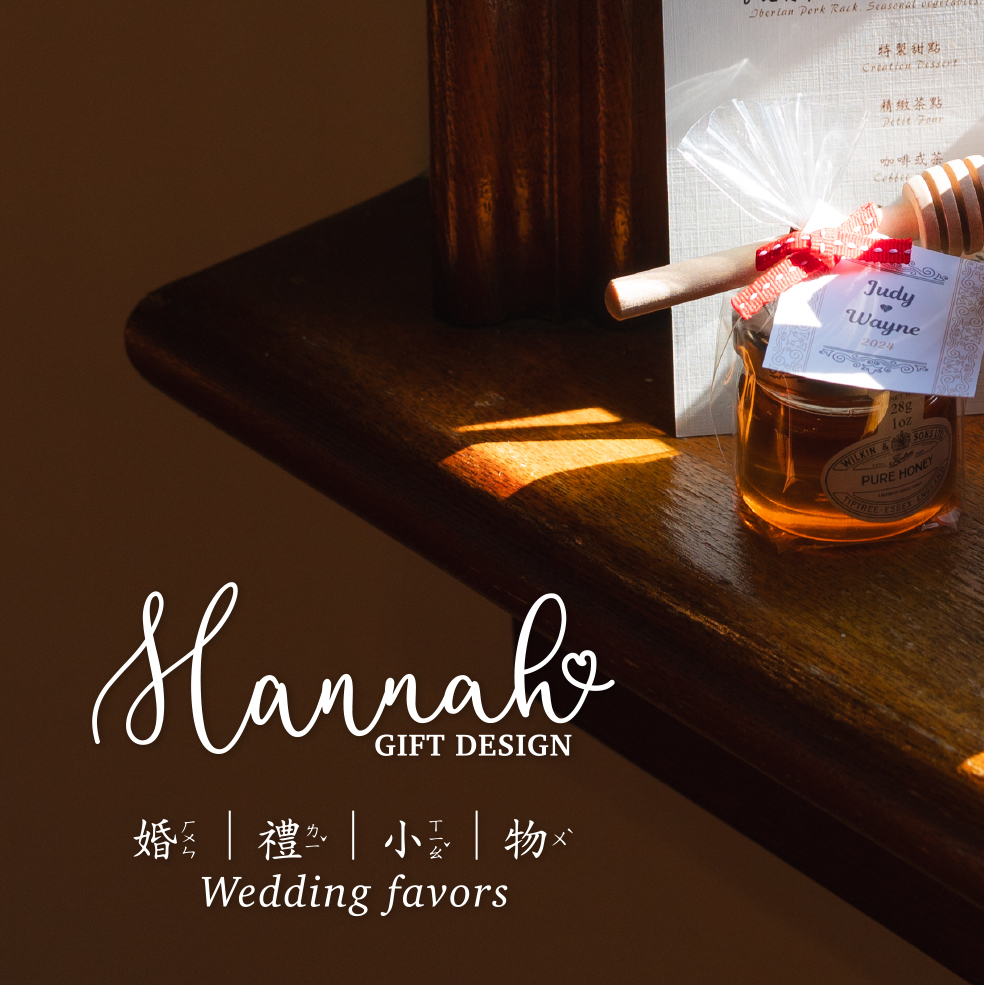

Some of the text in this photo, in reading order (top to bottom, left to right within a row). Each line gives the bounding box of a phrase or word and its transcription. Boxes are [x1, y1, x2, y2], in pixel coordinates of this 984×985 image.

[749, 8, 794, 18] Iberian
[798, 3, 826, 16] Pork
[866, 0, 916, 12] Seasonal
[878, 41, 940, 57] 特製甜點
[862, 58, 958, 72] Creation Dessert
[880, 96, 943, 113] 精緻茶點
[881, 115, 911, 127] Petit
[880, 151, 943, 167] 咖啡或茶
[864, 279, 915, 308] Judy
[845, 308, 921, 336] Wayne
[860, 337, 895, 351] 2024
[890, 400, 913, 415] 28g
[892, 416, 913, 430] 1oz
[841, 446, 876, 468] WILKIN
[882, 441, 890, 451] &
[913, 429, 933, 442] SONS
[861, 454, 934, 486] PURE HONEY
[843, 496, 879, 513] TIPTREE
[884, 500, 912, 513] ESSEX
